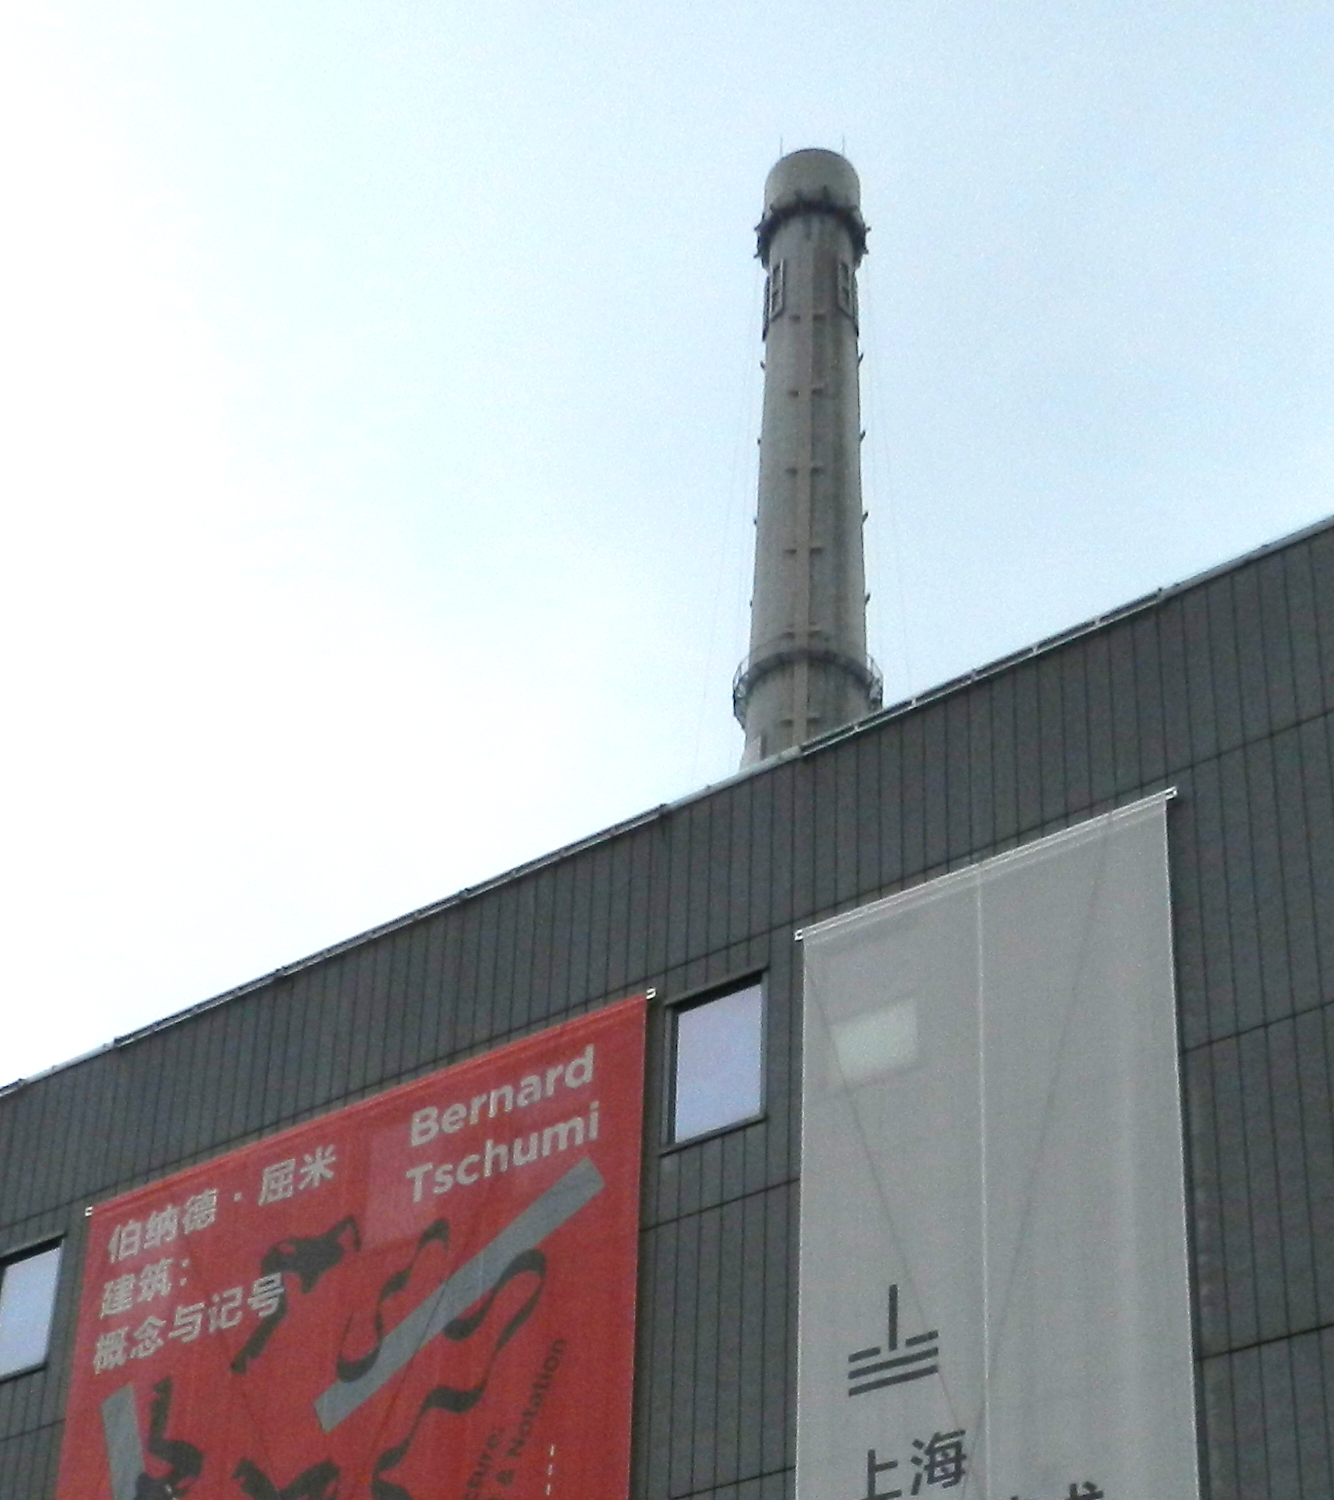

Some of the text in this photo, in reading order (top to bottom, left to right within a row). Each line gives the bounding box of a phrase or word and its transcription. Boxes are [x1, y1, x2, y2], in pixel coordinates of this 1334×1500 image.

[409, 1044, 595, 1147] Bernard
[405, 1102, 601, 1202] Tschumi
[93, 1272, 287, 1375] 概念与记号
